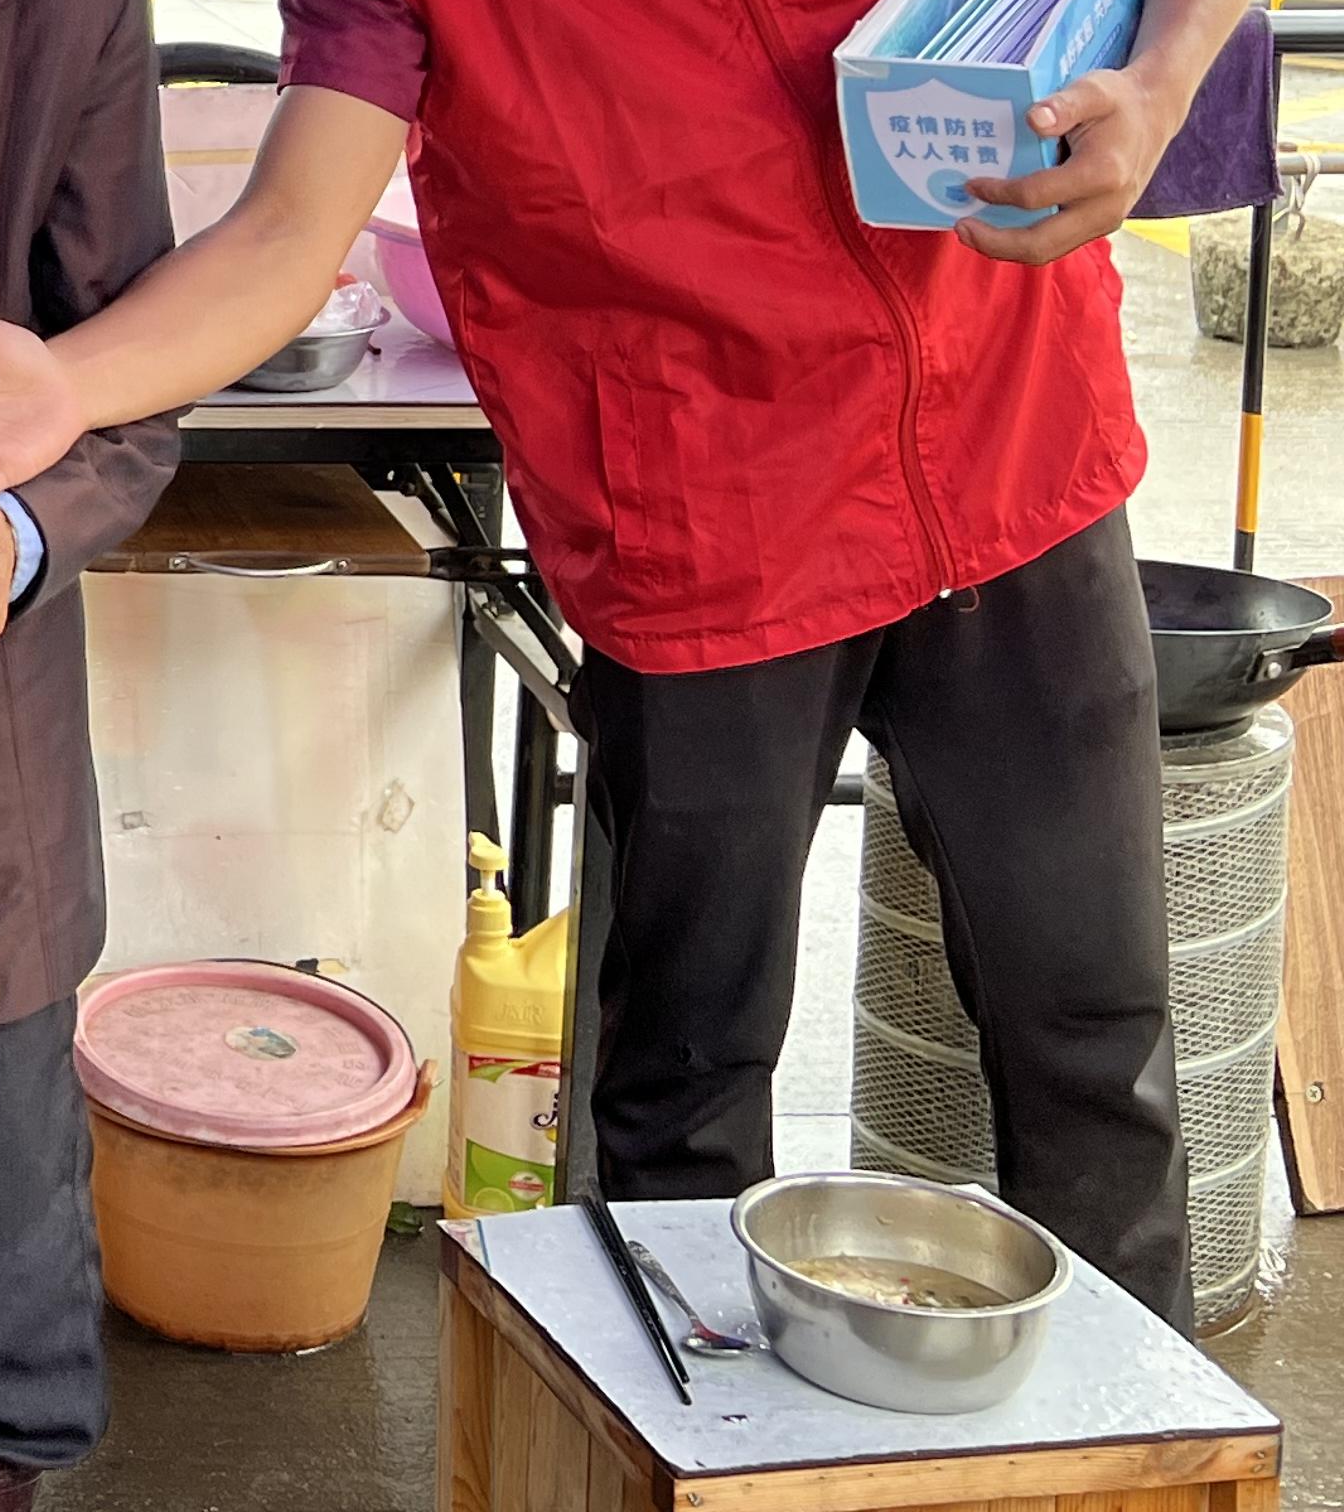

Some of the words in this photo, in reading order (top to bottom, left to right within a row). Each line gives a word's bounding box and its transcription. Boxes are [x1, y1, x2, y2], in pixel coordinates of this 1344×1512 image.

[888, 115, 996, 138] 疫情防控
[894, 141, 1000, 165] 人人有责
